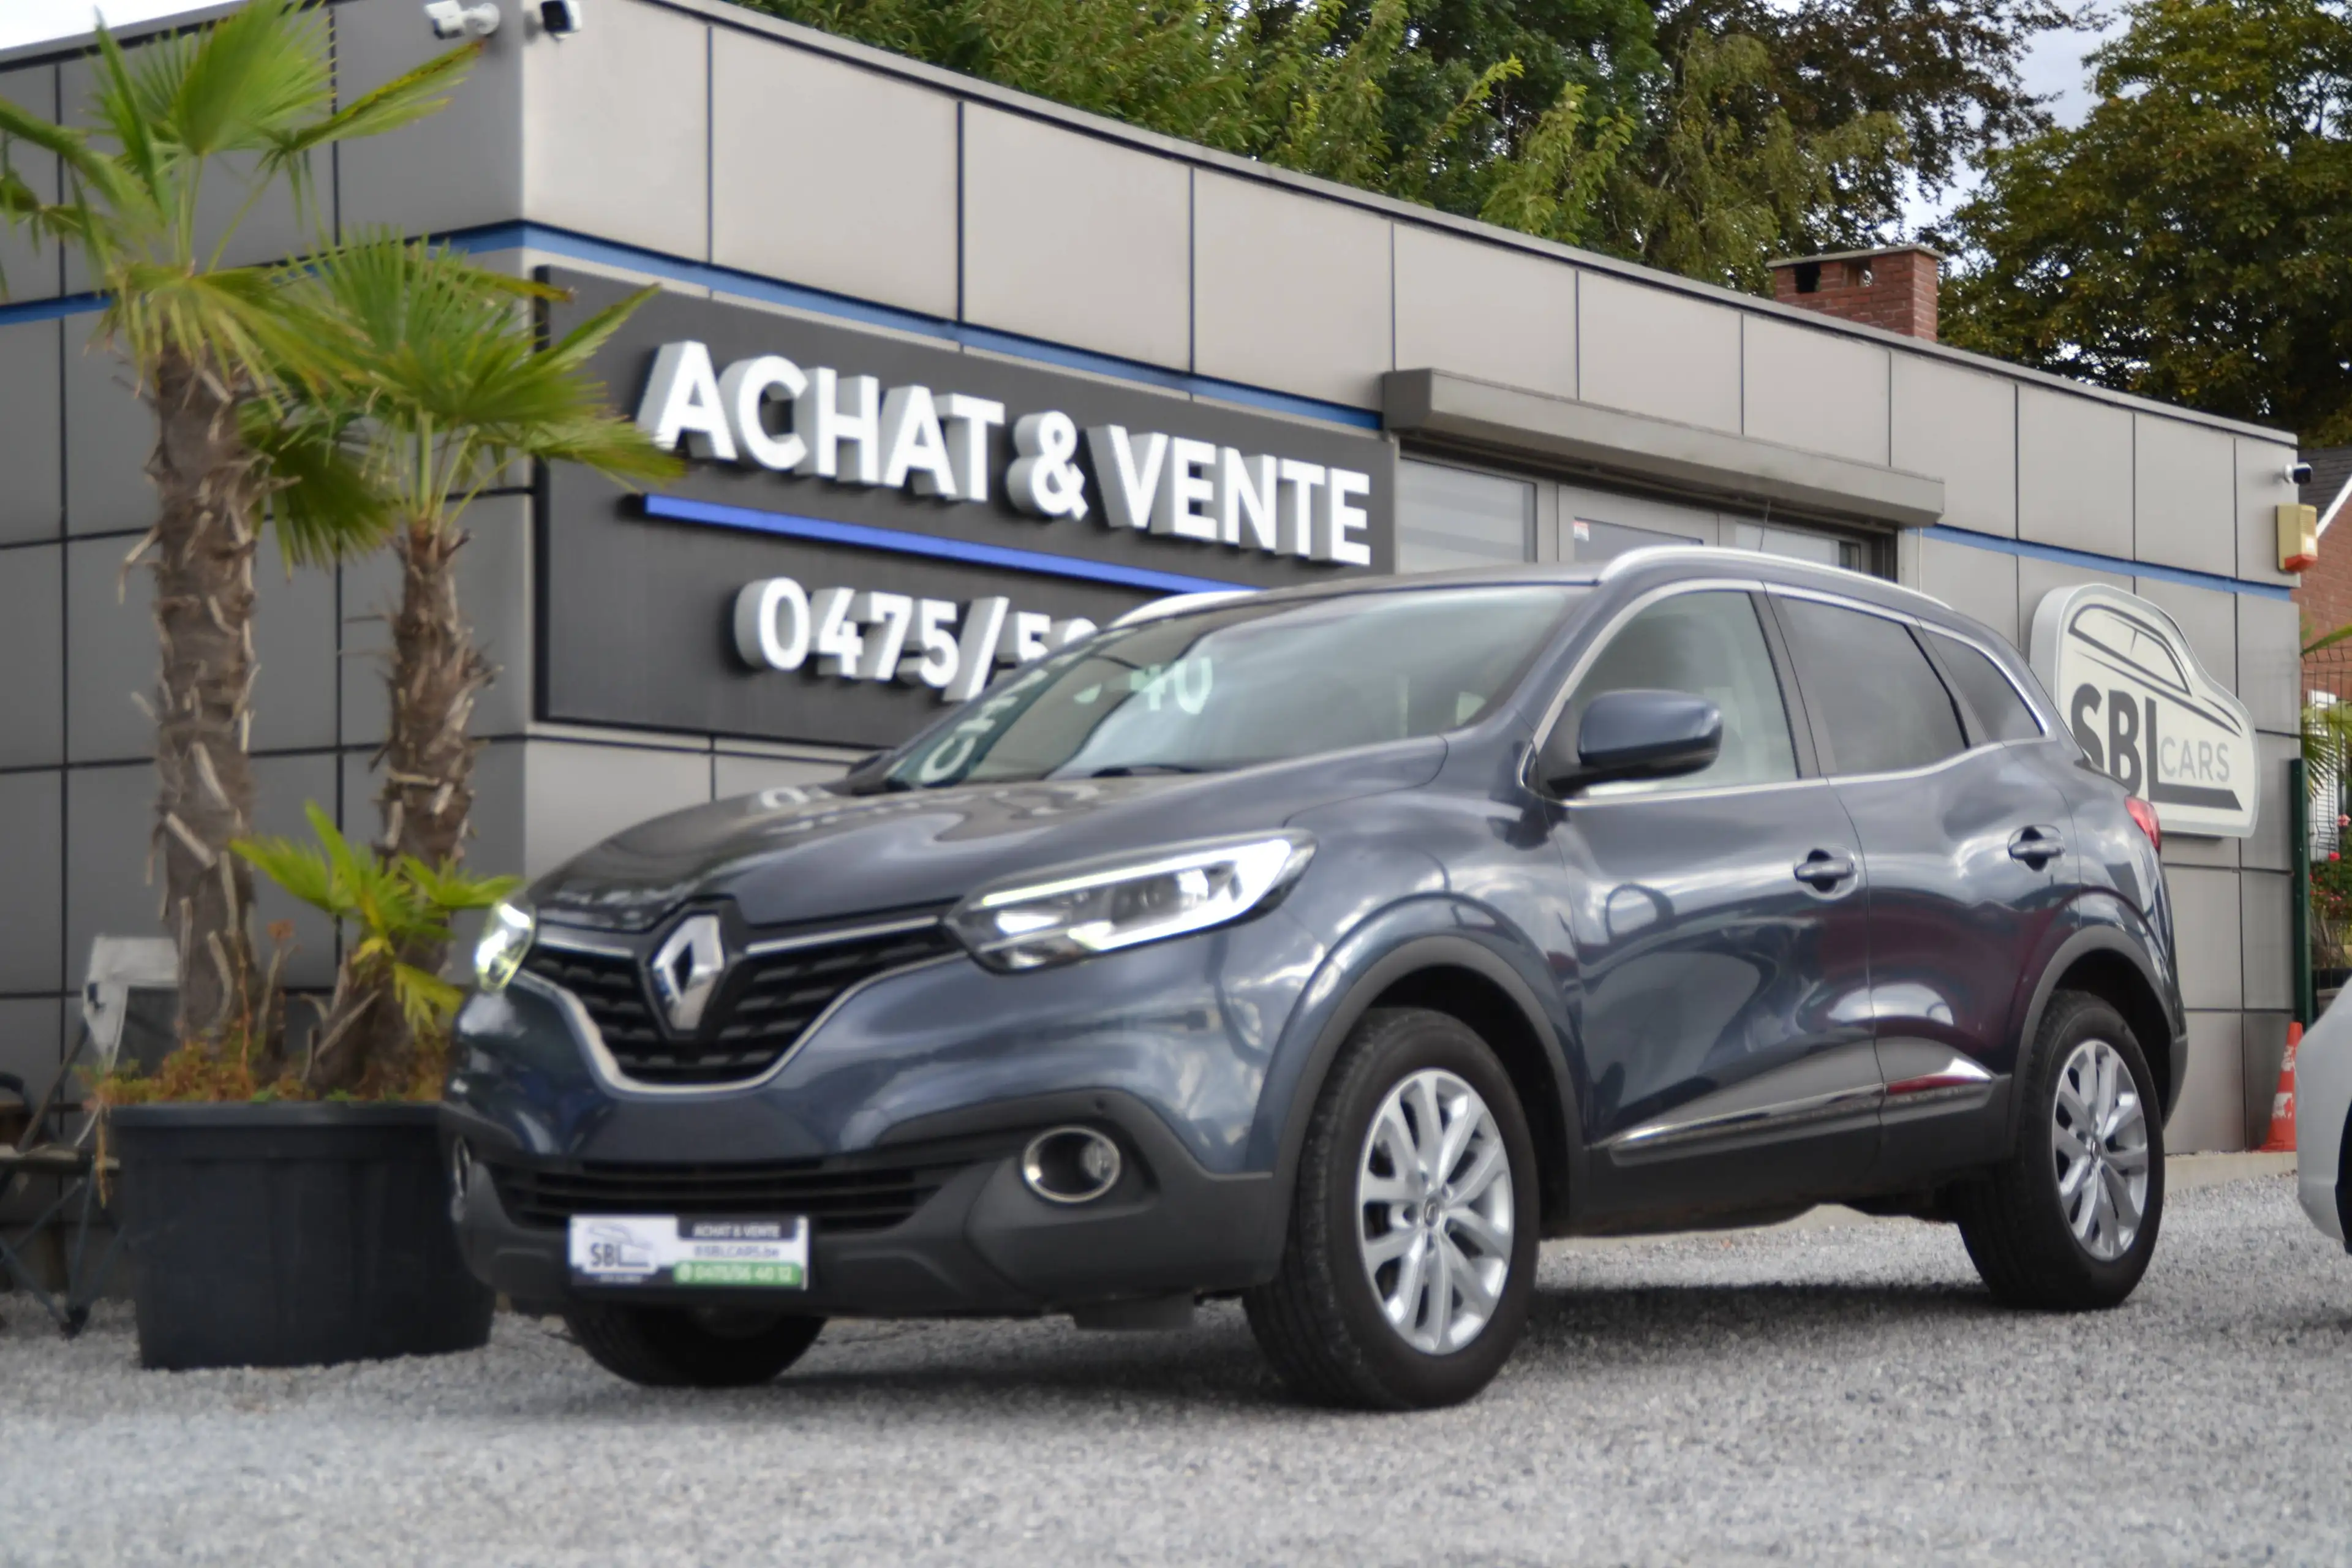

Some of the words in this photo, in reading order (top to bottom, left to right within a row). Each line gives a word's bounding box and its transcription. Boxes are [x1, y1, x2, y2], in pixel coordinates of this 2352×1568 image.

[637, 340, 1005, 501] ACHAT
[1007, 410, 1089, 521] &
[1087, 424, 1371, 566] VENTE
[2071, 682, 2243, 812] SBL
[2160, 736, 2230, 783] CARS
[590, 1242, 649, 1267] SBL
[693, 1223, 731, 1237] ACHAT
[742, 1223, 781, 1238] VENTE
